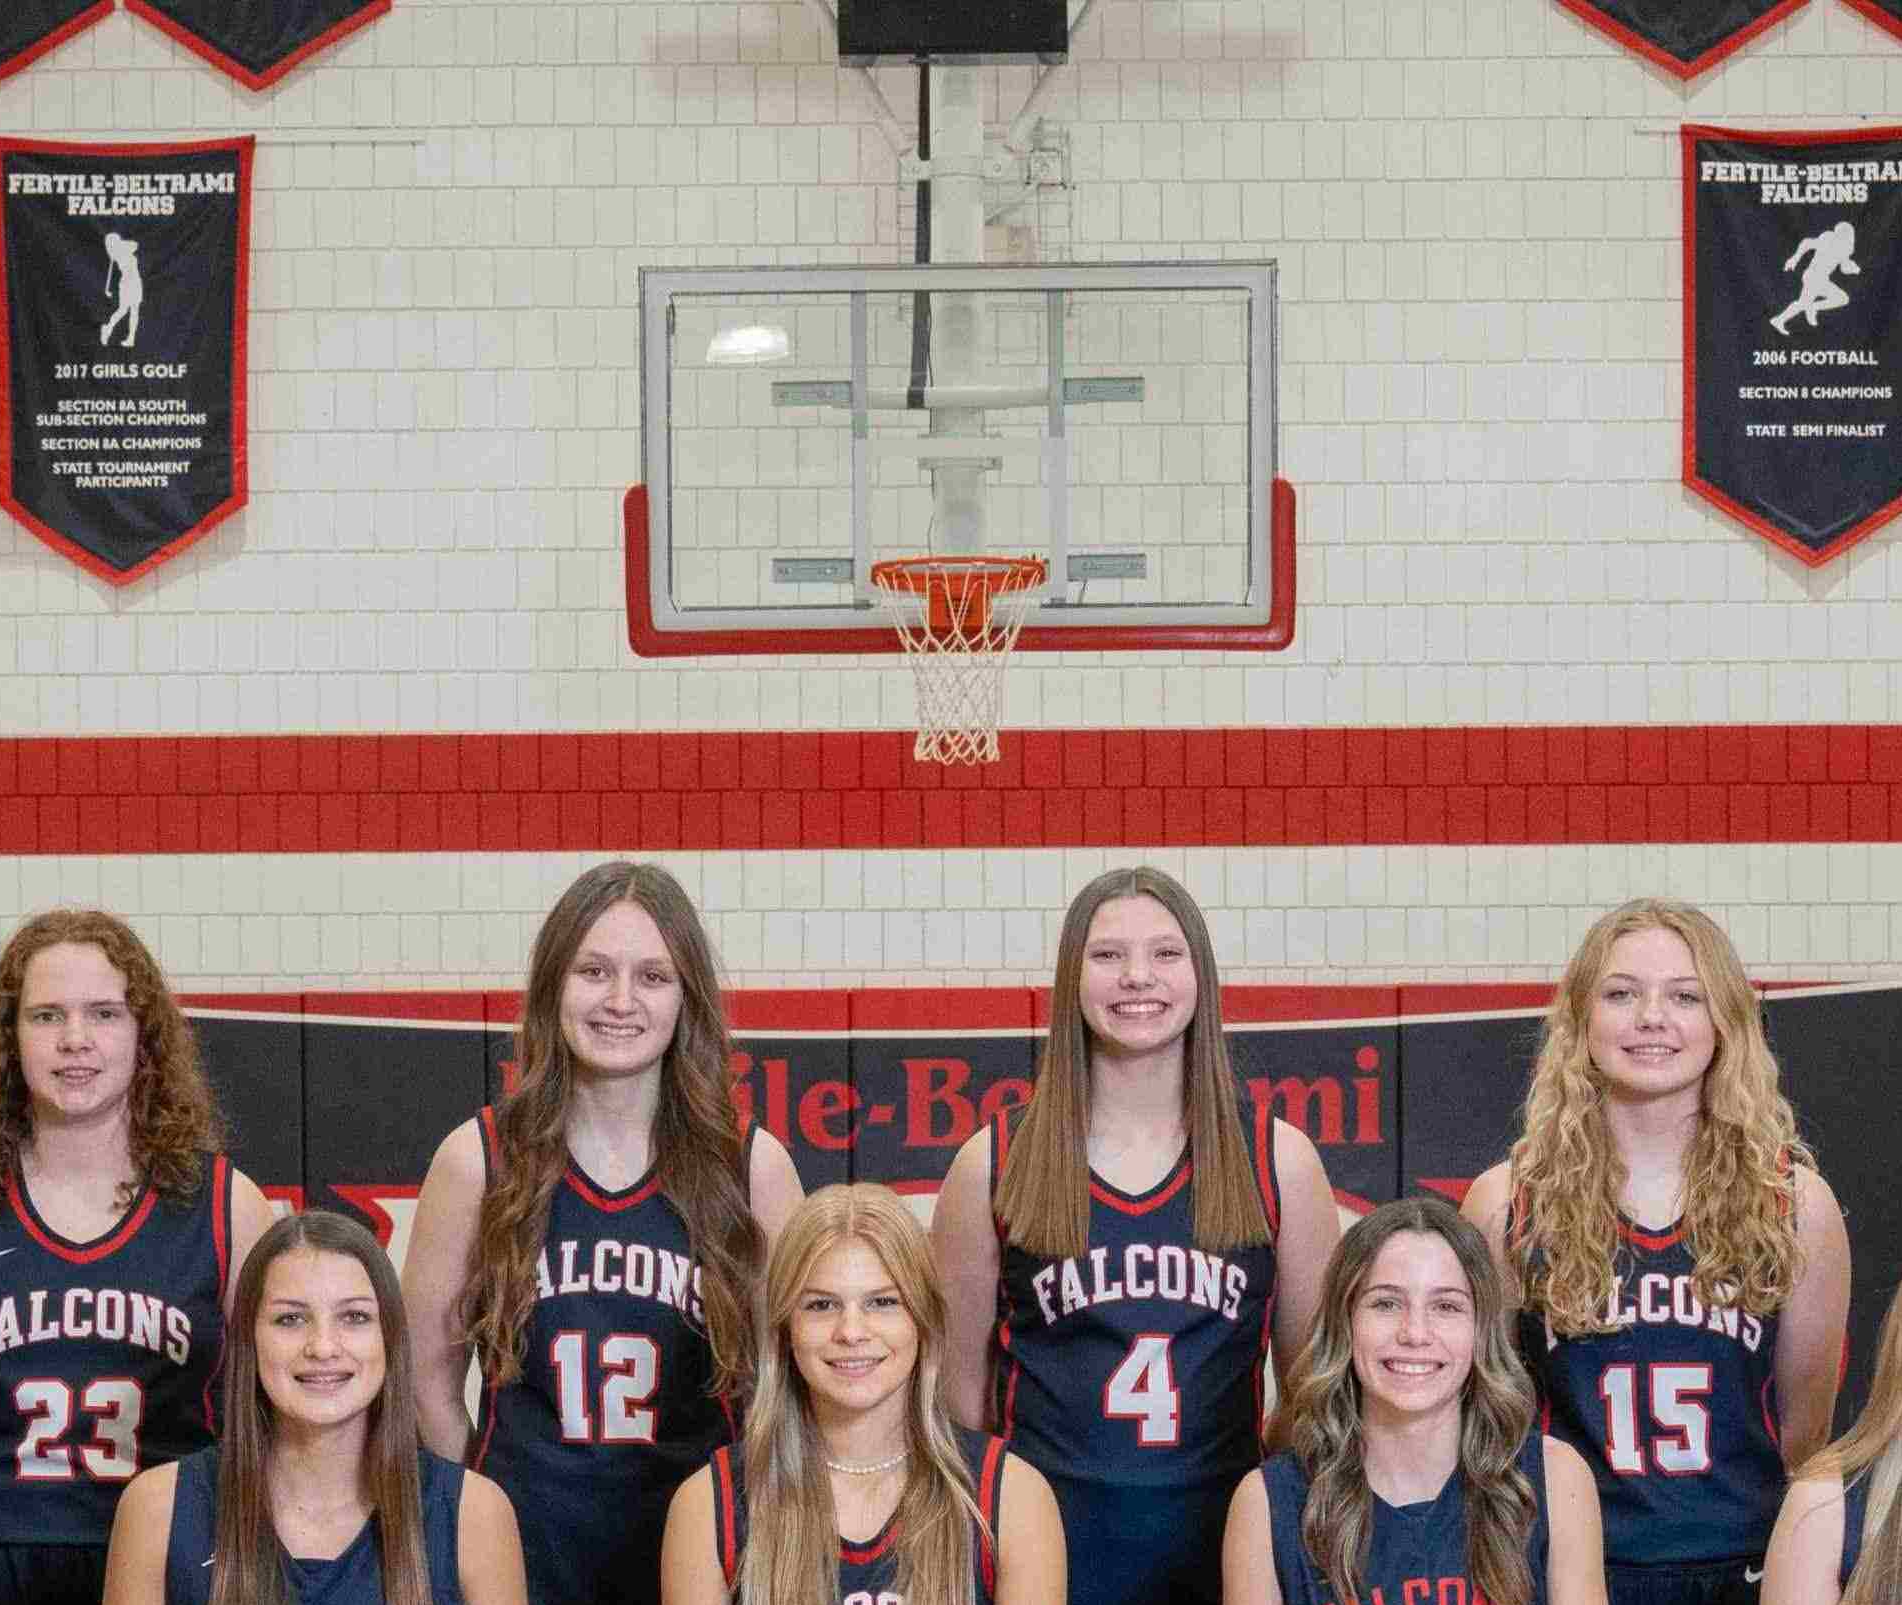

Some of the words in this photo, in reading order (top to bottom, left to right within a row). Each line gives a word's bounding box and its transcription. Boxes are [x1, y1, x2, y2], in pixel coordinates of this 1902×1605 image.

[8, 173, 235, 194] FERTILE-BELTRAMI
[1761, 183, 1869, 204] FALCONS
[67, 196, 175, 216] FALCONS
[1753, 351, 1787, 365] 2006
[1791, 351, 1879, 365] FOOTBALL
[54, 365, 88, 379] 2017
[92, 364, 138, 379] GIRLS
[143, 364, 187, 378] GOLF
[1738, 387, 1798, 399] SECTION
[1811, 387, 1893, 399] CHAMPIONS
[58, 400, 116, 412] SECTION
[139, 400, 186, 411] SOUTH
[36, 414, 124, 427] SUB-SECTION
[127, 413, 207, 426] CHAMPIONS
[1746, 425, 1786, 437] STATE
[1792, 424, 1823, 437] SEMI
[1826, 424, 1886, 437] FINALIST
[41, 438, 98, 450] SECTION
[122, 438, 201, 449] CHAMPIONS
[52, 462, 92, 474] STATE
[97, 461, 190, 474] TOURNAMENT
[76, 475, 168, 488] PARTICIPANTS
[536, 1240, 705, 1324] ALCON
[1032, 1244, 1248, 1326] FALCONS
[551, 1329, 661, 1445] 12
[1105, 1334, 1181, 1447] 4
[12, 1376, 143, 1481] 23
[1600, 1362, 1714, 1478] 15
